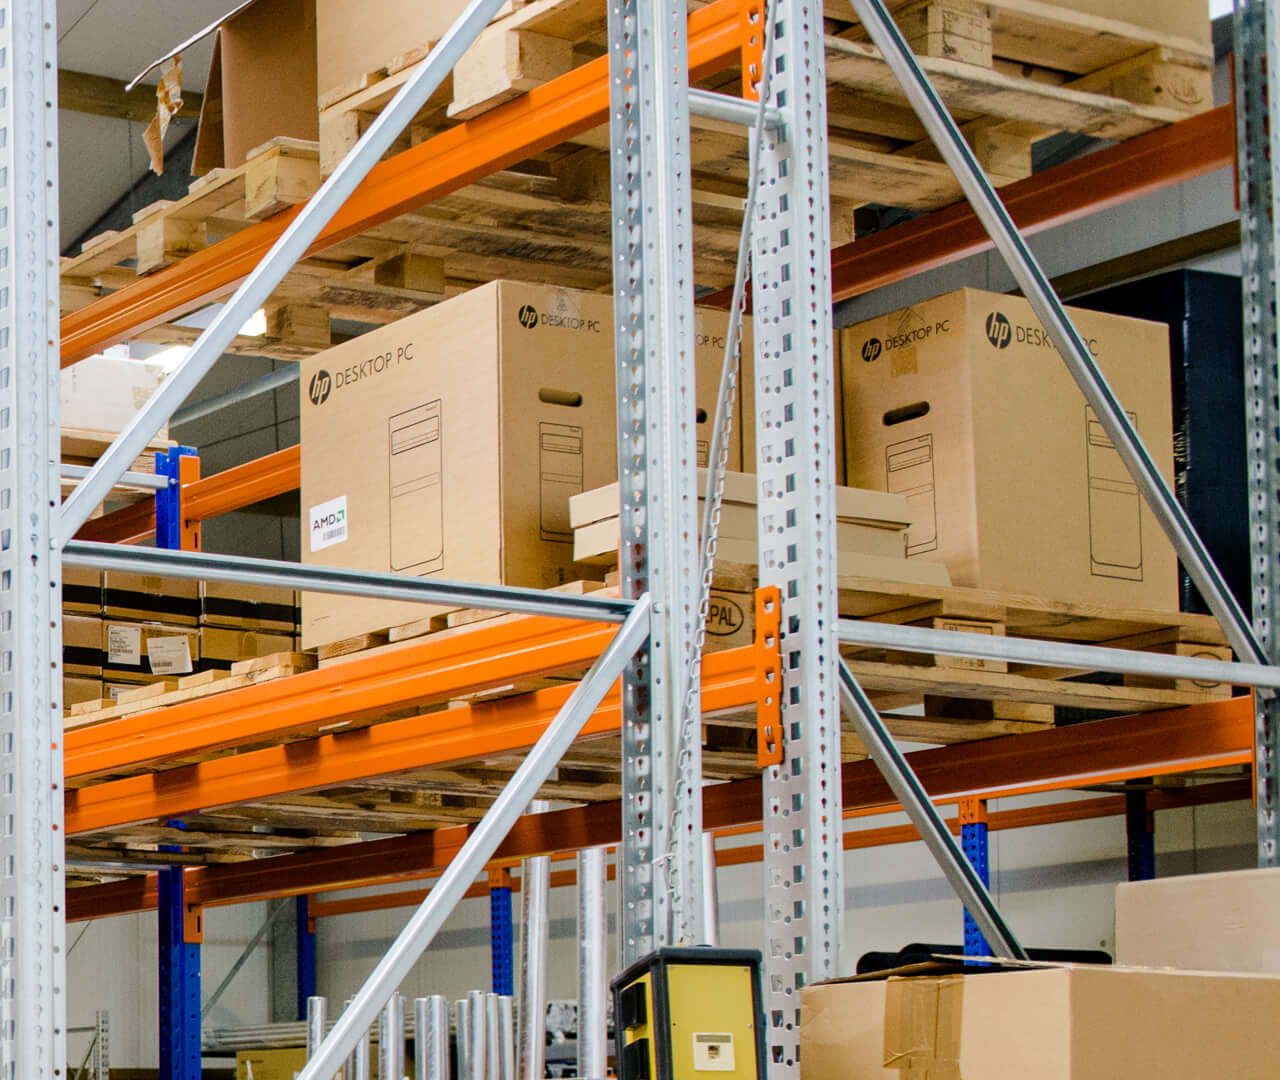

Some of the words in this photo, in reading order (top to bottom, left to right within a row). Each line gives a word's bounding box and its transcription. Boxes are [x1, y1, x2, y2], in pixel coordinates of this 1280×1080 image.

[519, 304, 538, 329] hp
[541, 312, 586, 331] DESKTOP
[587, 319, 601, 333] PC
[986, 312, 1012, 350] hp
[1016, 326, 1056, 349] DESK
[862, 338, 882, 362] hp
[885, 326, 933, 352] DESKTOP
[935, 319, 951, 335] PC
[309, 369, 332, 406] hp
[335, 352, 393, 389] DESKTOP
[395, 343, 415, 363] PC
[312, 513, 337, 532] AMD
